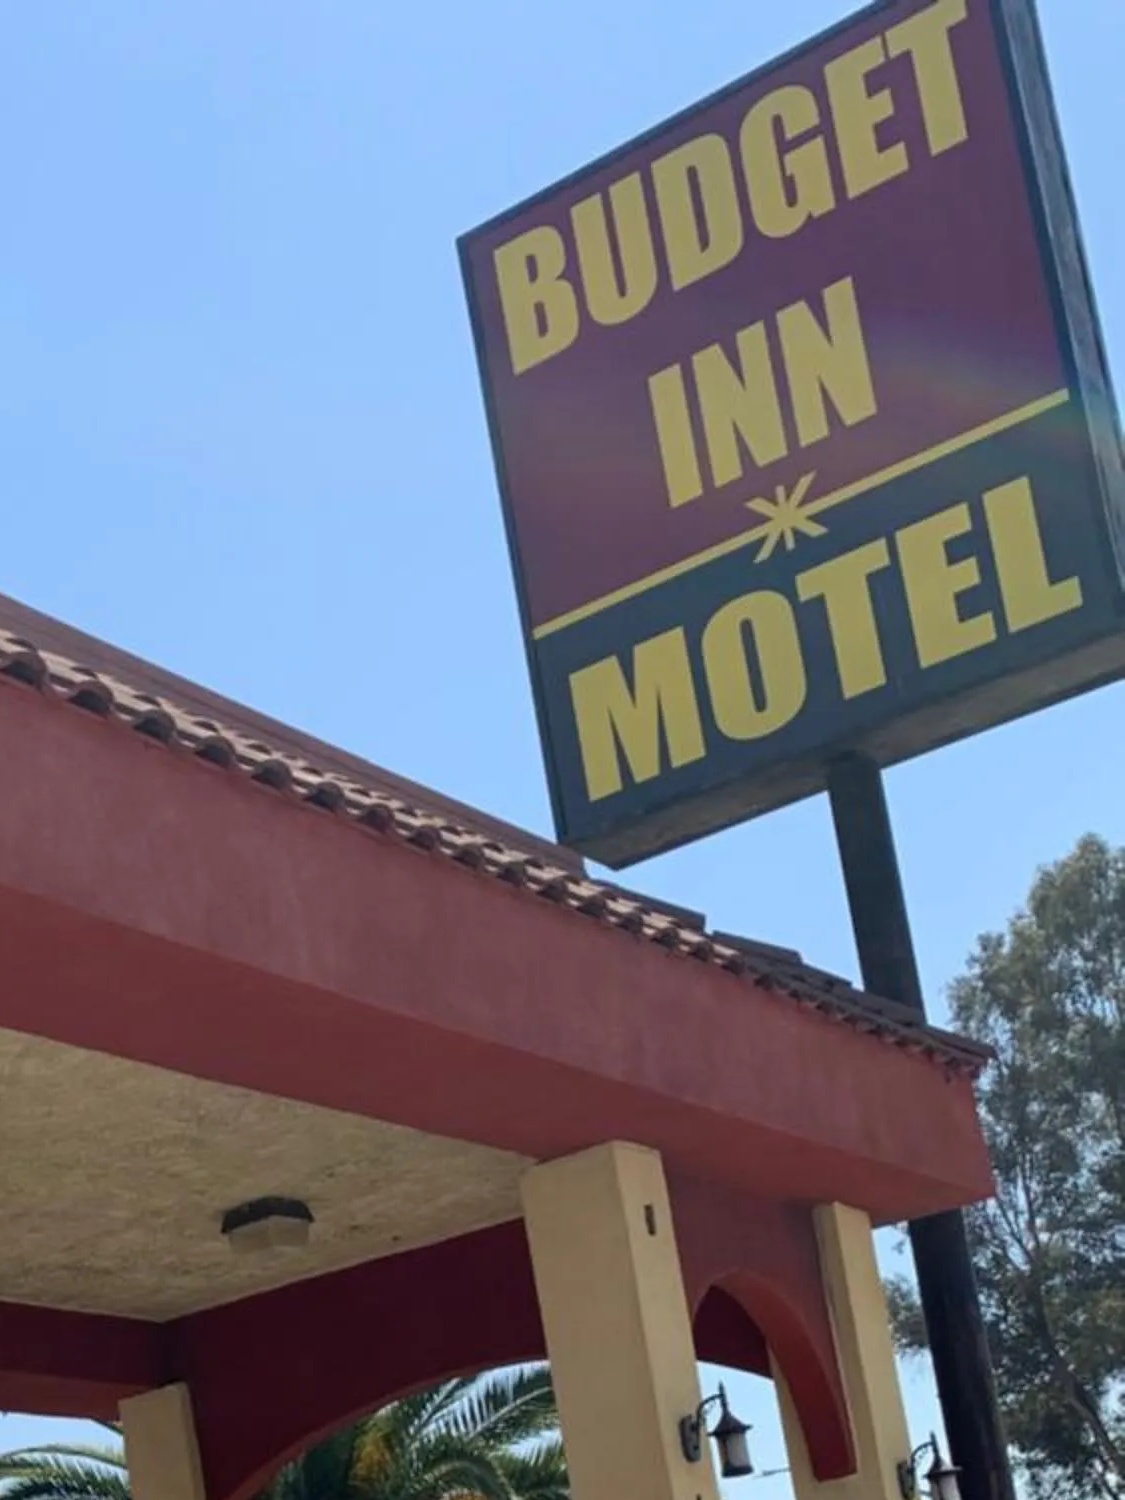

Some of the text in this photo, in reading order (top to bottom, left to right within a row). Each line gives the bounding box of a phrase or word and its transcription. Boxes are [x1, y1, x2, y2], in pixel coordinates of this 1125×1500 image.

[494, 0, 969, 376] BUDGET
[648, 276, 877, 508] INN
[568, 475, 1083, 802] MOTEL
